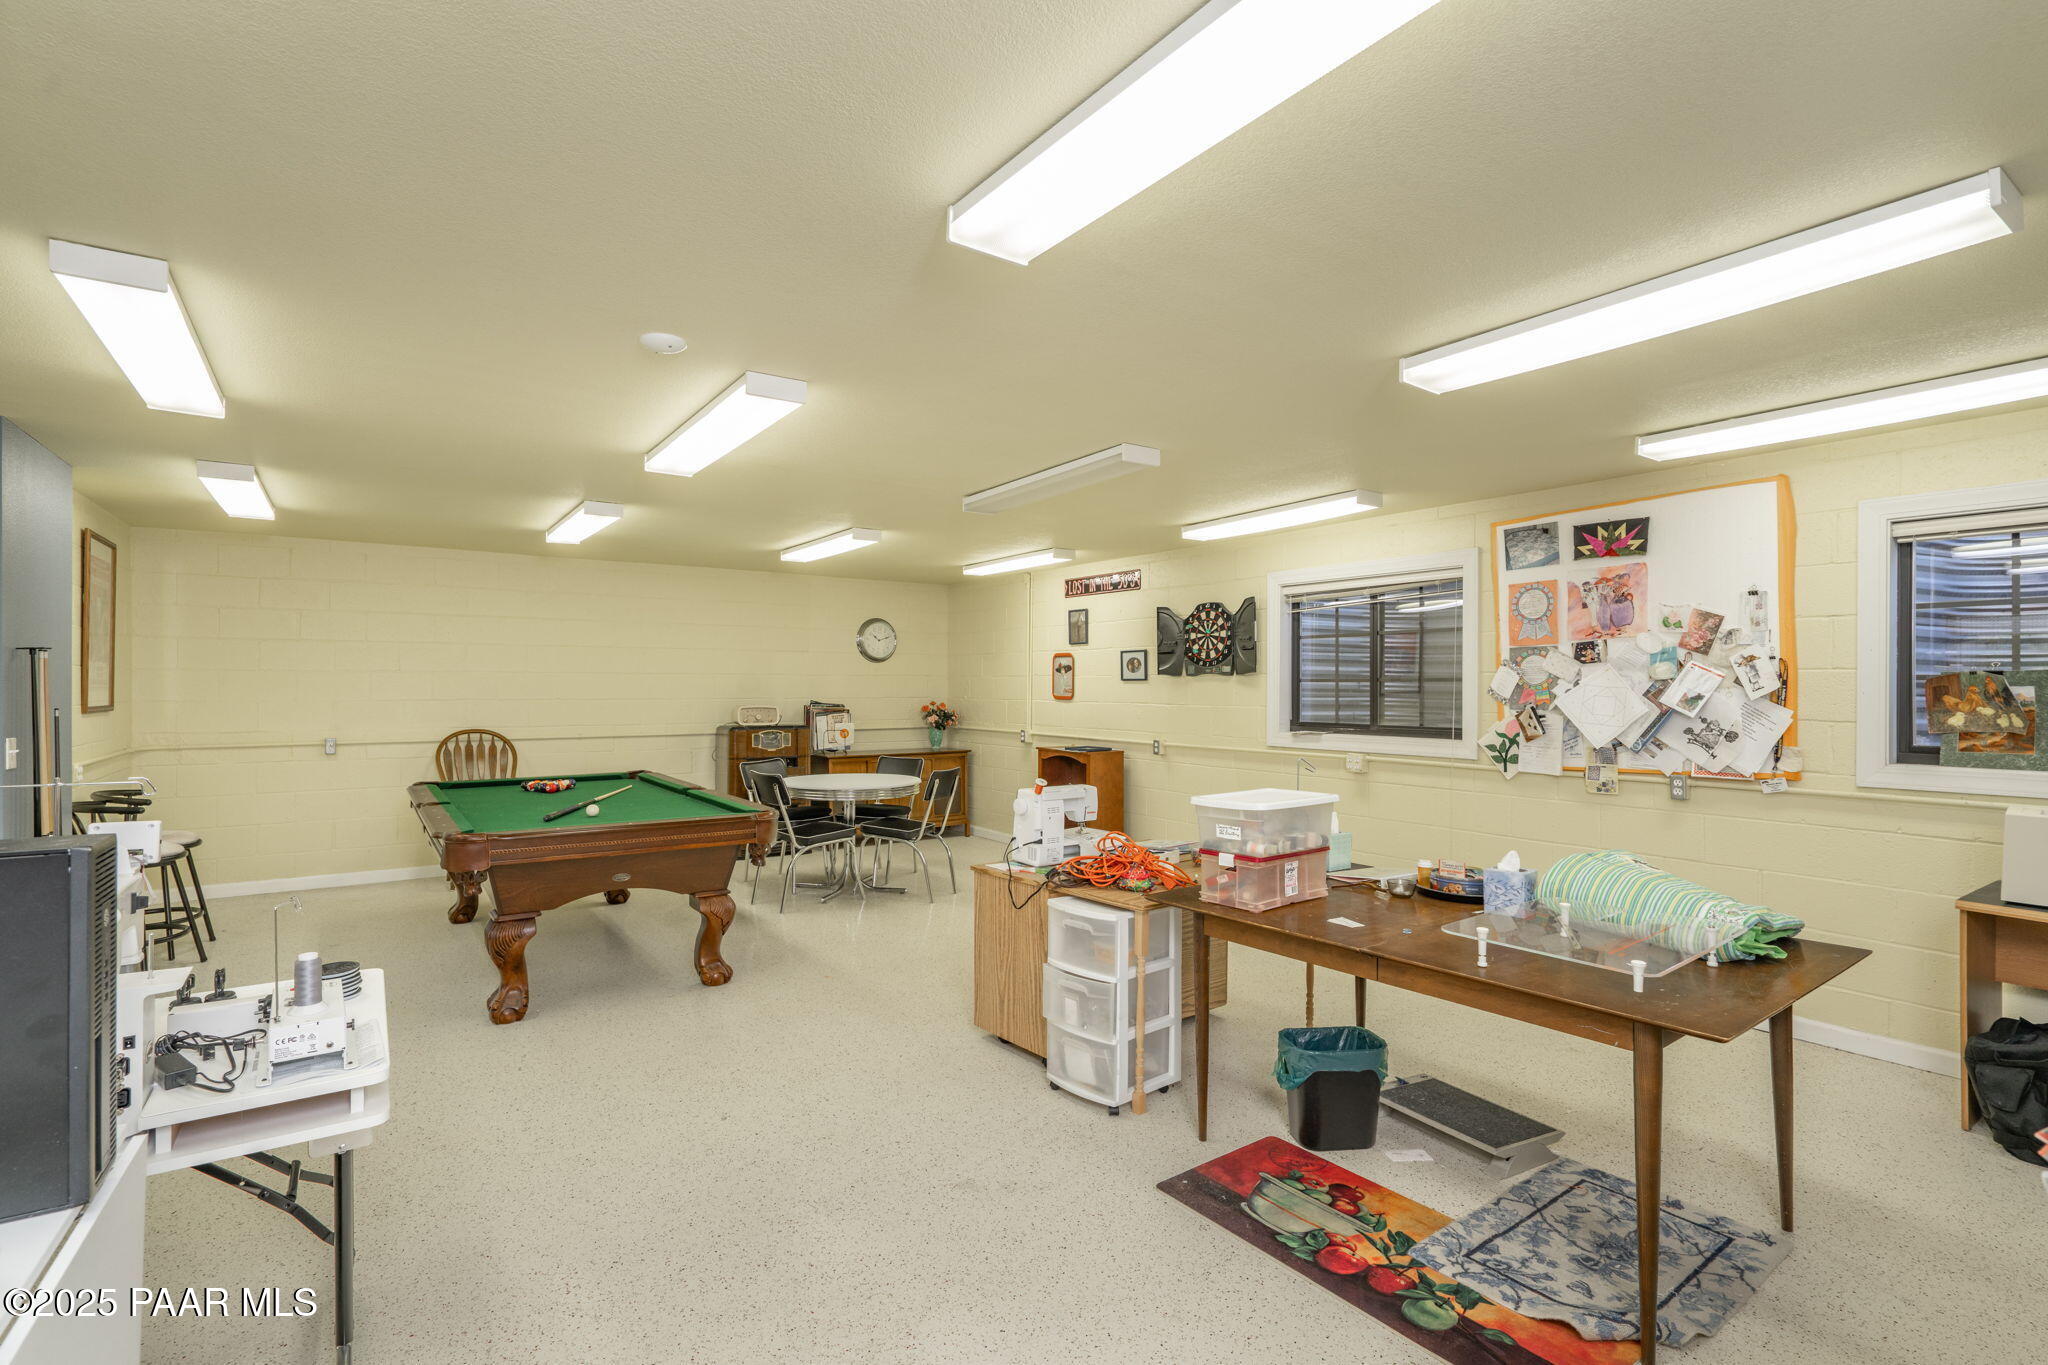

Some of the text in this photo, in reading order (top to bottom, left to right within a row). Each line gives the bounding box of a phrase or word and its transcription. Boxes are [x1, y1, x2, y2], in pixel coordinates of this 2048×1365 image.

[1068, 579, 1087, 595] LOST
[1089, 578, 1097, 592] IN
[1100, 576, 1113, 591] THE
